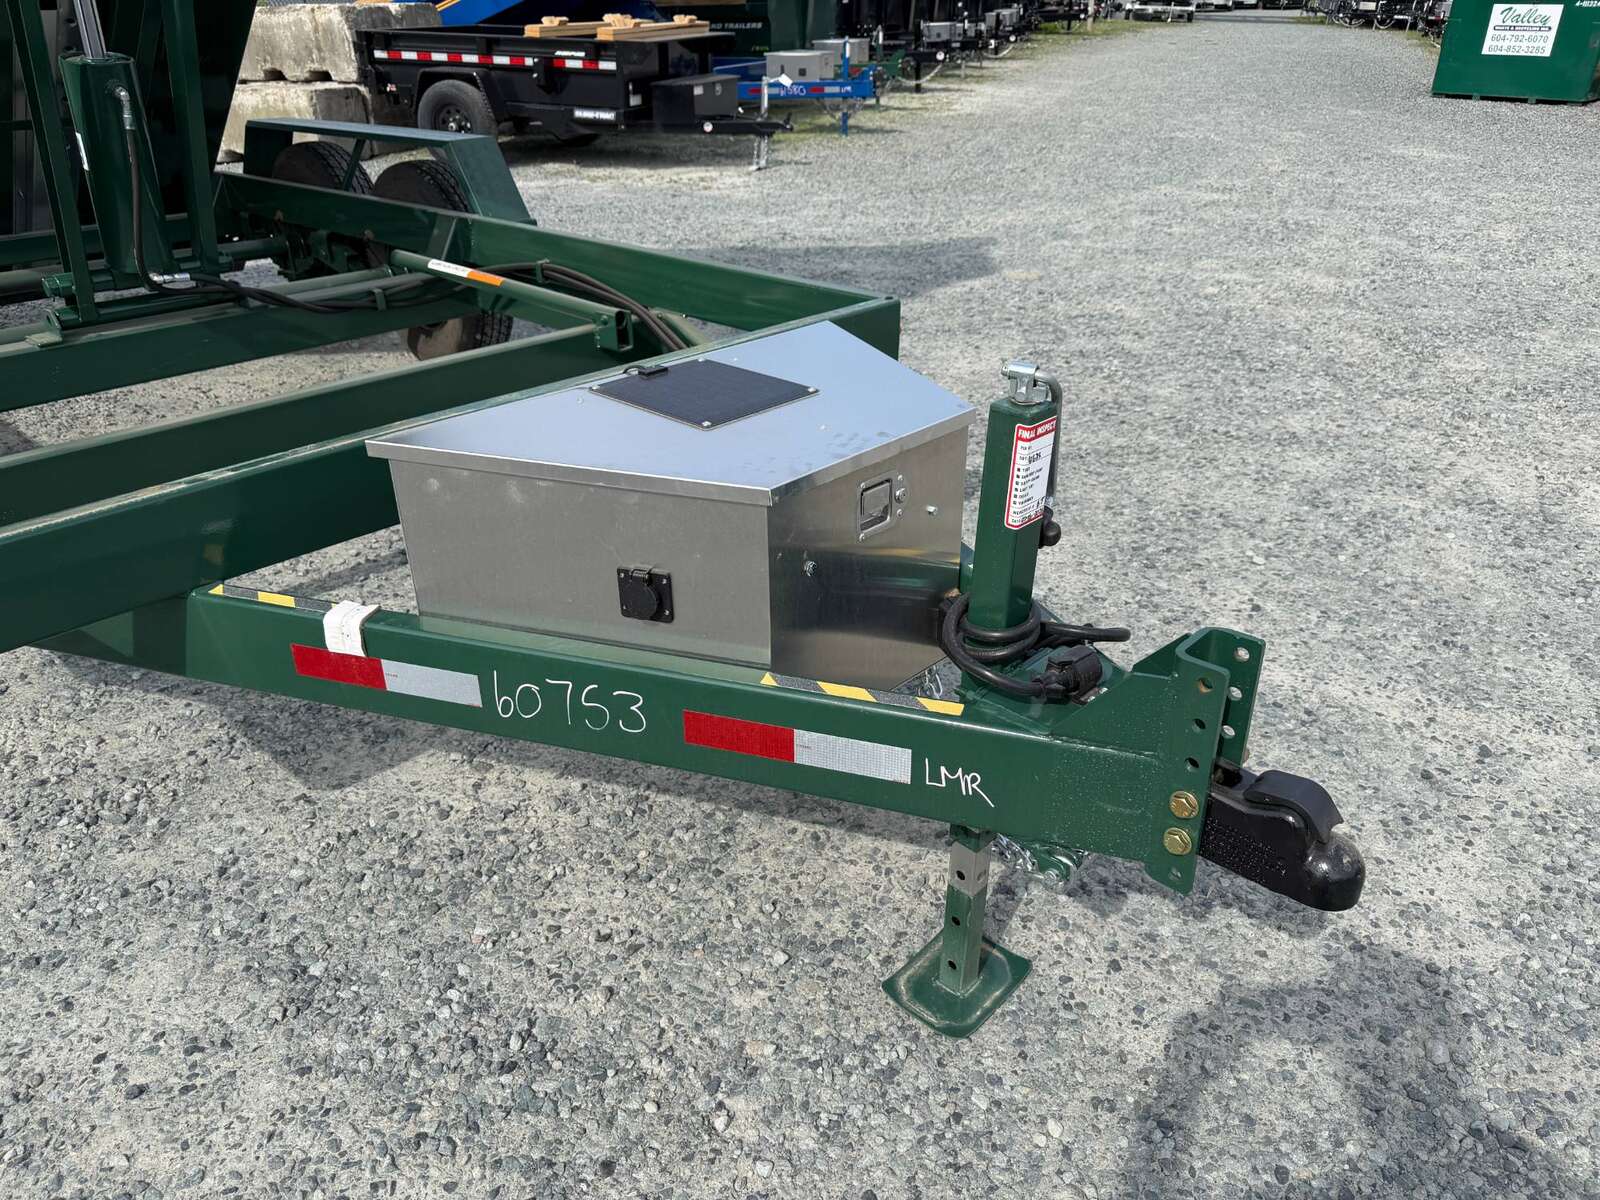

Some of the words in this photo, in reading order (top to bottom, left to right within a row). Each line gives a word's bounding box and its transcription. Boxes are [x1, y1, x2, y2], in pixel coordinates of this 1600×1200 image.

[1500, 6, 1551, 26] Valley
[1491, 33, 1549, 44] 604-792-6070
[1017, 428, 1036, 440] FINAL
[493, 670, 647, 733] 60753
